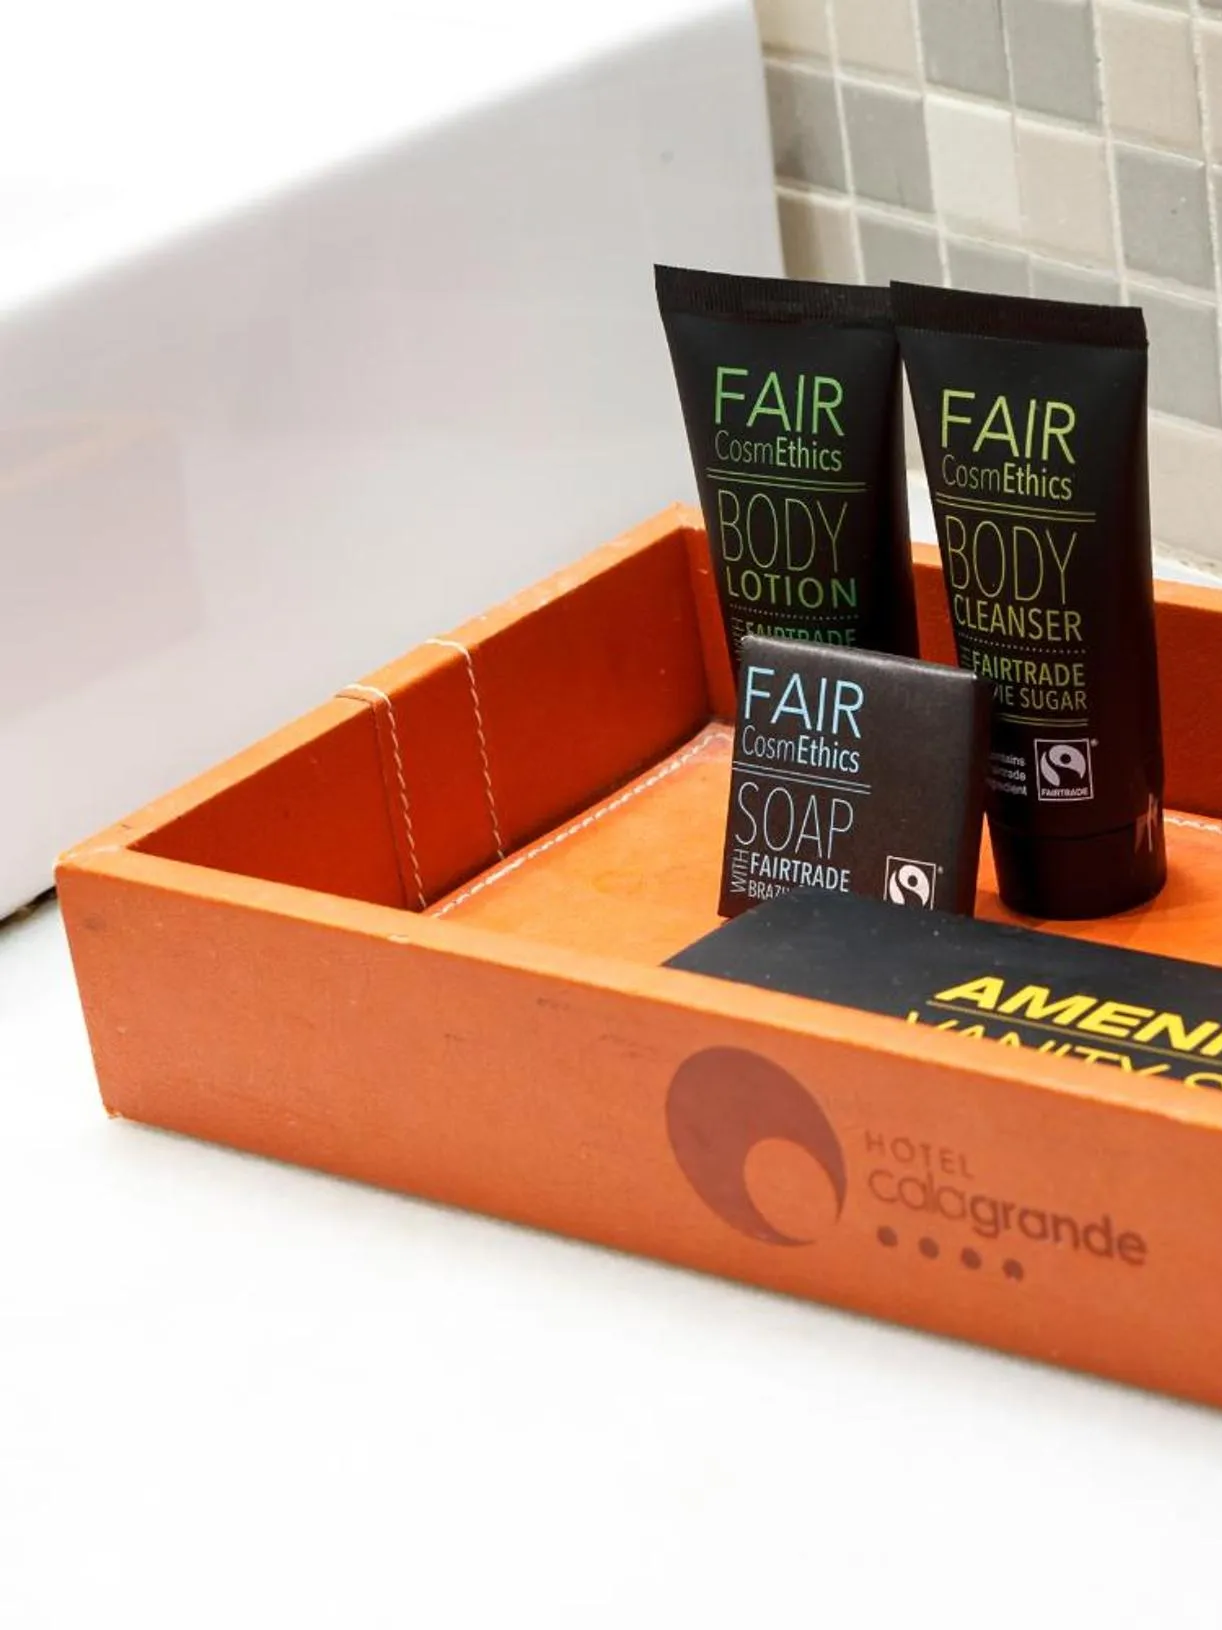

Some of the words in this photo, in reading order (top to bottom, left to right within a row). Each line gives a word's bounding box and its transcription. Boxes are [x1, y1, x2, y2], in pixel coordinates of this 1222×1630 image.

[714, 366, 846, 437] FAIR
[714, 430, 843, 472] CosmEthics
[941, 388, 1077, 465] FAIR
[942, 453, 1073, 502] CosmEthics
[717, 489, 849, 574] BODY
[944, 514, 1078, 605] BODY
[725, 566, 858, 609] LOTION
[953, 594, 1083, 642] CLEANSER
[972, 650, 1087, 688] FAIRTRADE
[744, 665, 865, 740] FAIR
[1019, 686, 1088, 711] SUGAR
[741, 724, 861, 774] CosmEthics
[1040, 786, 1089, 798] FAIRTRADE
[735, 781, 854, 859] SOAP
[730, 848, 750, 894] WITH
[750, 851, 851, 893] FAIRTRADE
[864, 1130, 975, 1181] HOTEL
[867, 1168, 1149, 1268] calagrande
